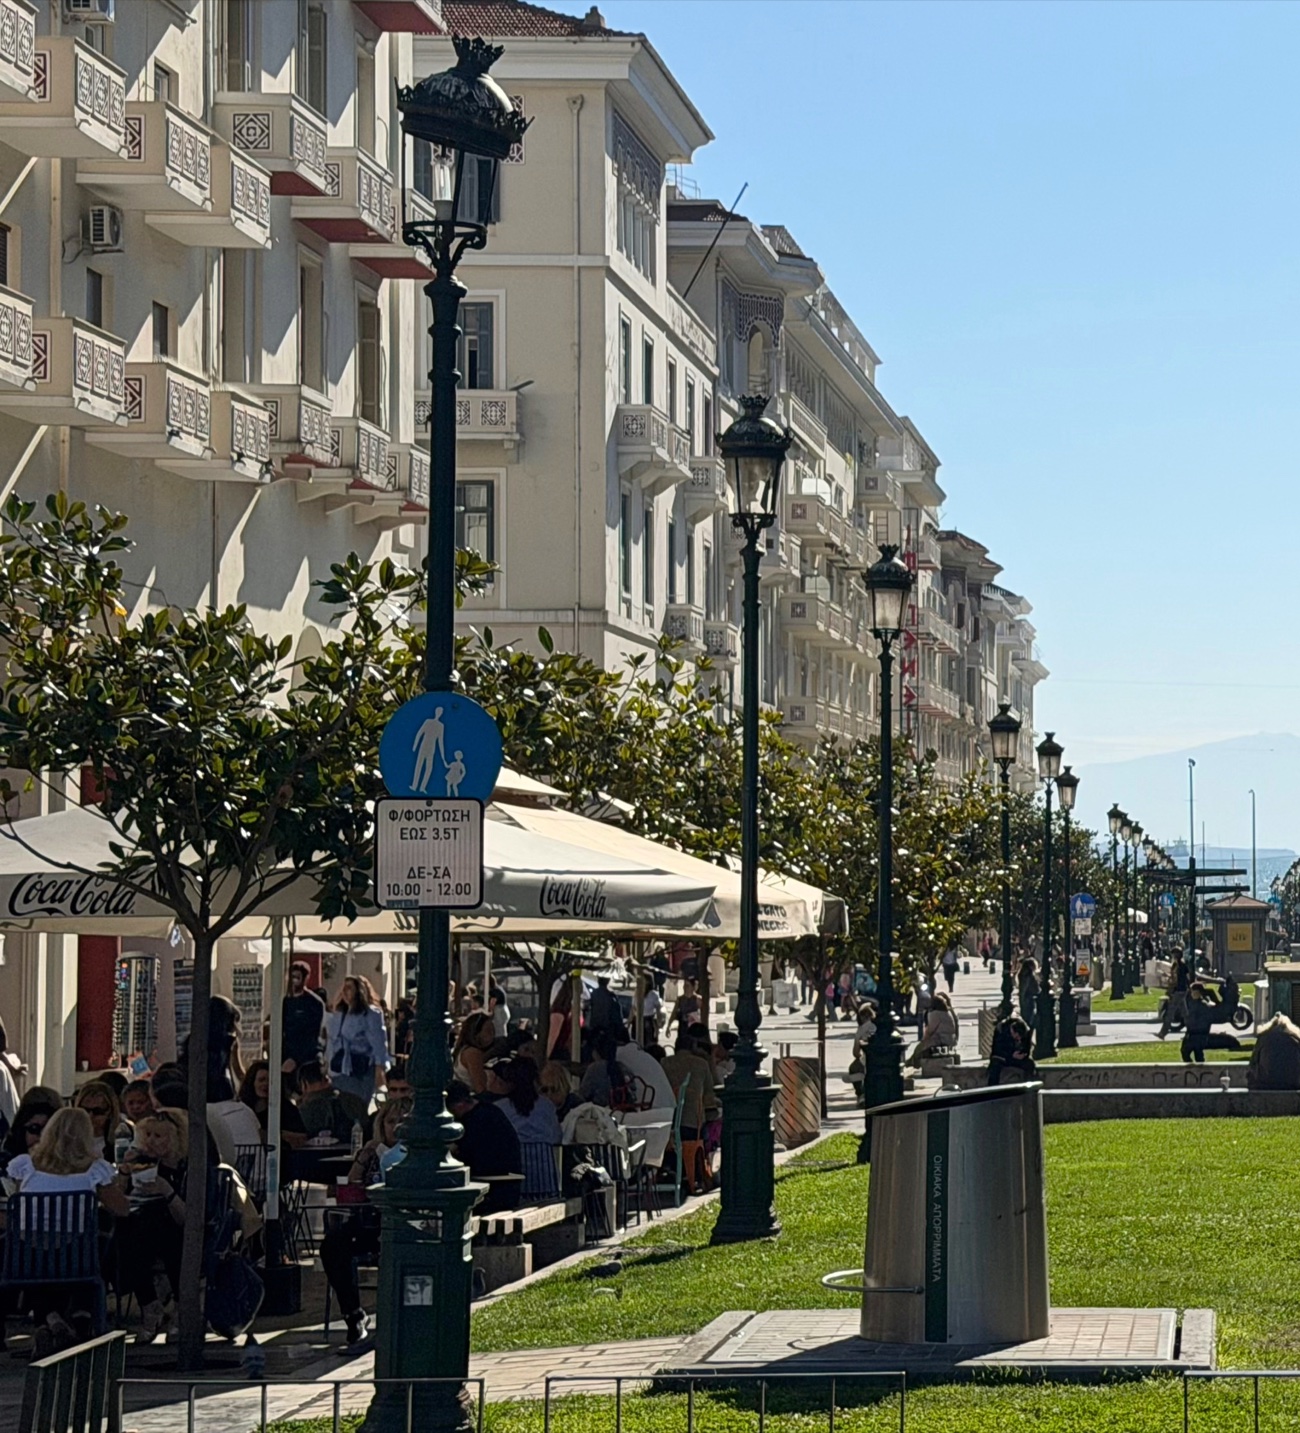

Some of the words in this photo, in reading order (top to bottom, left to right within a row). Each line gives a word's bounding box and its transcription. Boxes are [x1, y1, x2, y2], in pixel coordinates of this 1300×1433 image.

[388, 809, 471, 823] Φ/ΦΟΡΤΩΣΗ
[400, 827, 427, 841] ΕΩΣ
[406, 866, 452, 880] ΔΕ-ΣΑ
[386, 883, 421, 897] 10:00
[438, 882, 472, 896] 12:00
[932, 1154, 943, 1198] ΟΙΚΙΑΚΑ
